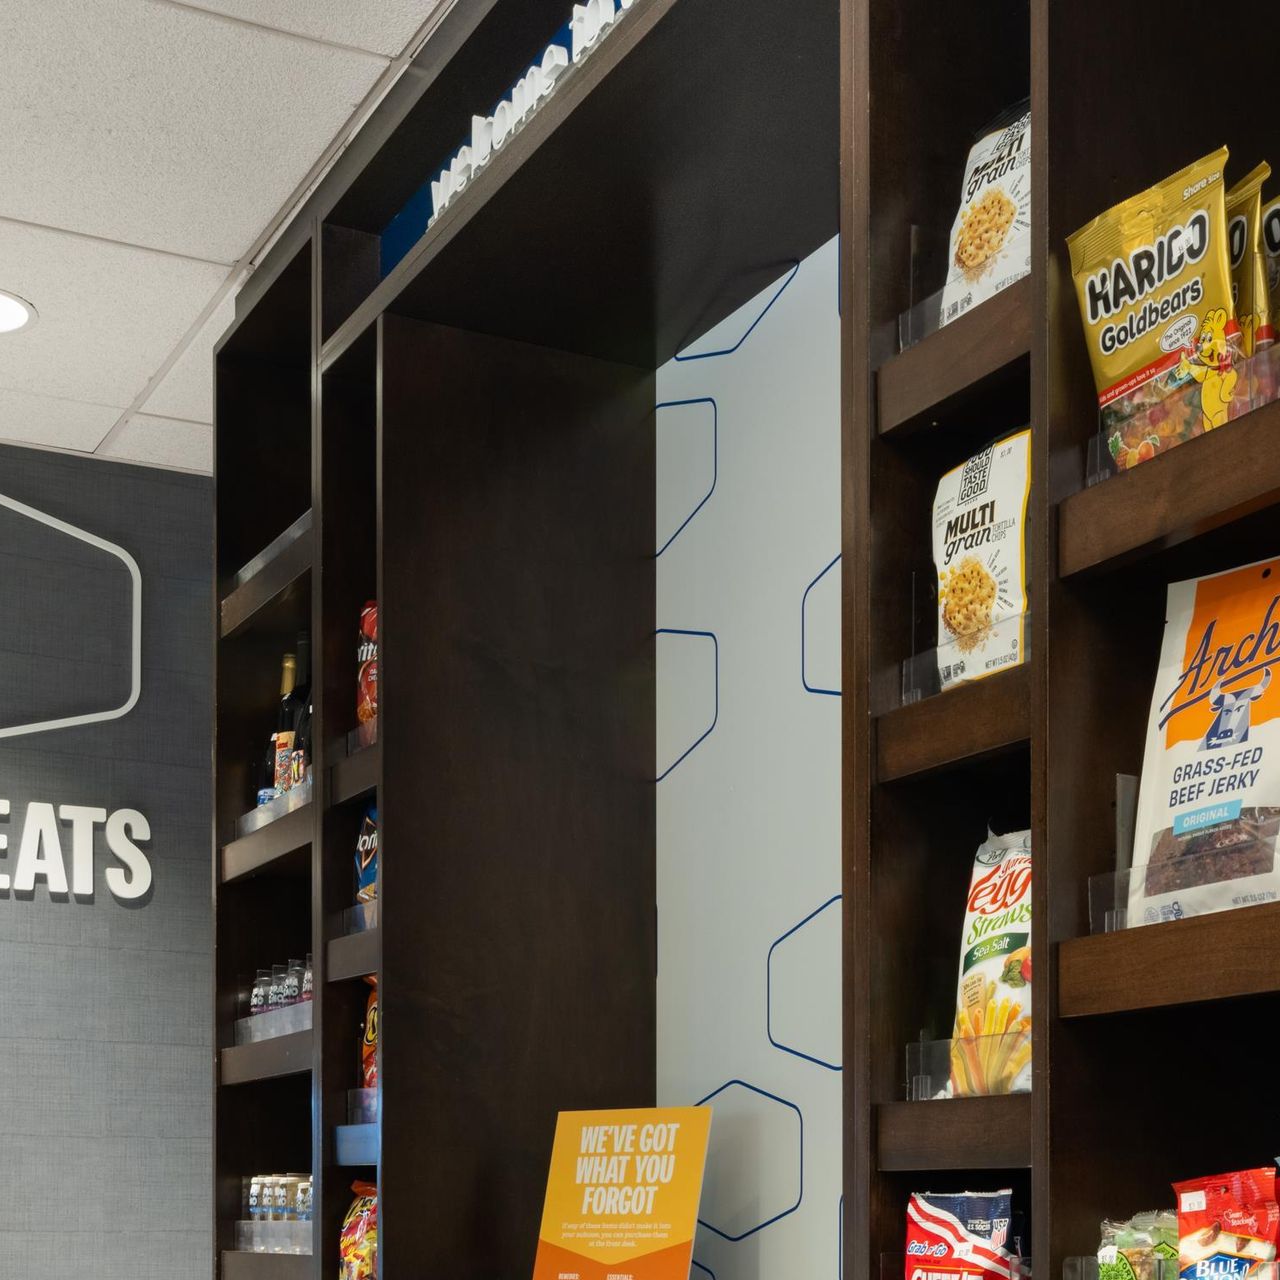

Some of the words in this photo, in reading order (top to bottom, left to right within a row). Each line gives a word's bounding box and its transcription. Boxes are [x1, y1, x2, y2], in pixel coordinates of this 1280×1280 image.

[965, 156, 1017, 204] grain
[1183, 178, 1207, 201] Share
[1100, 276, 1203, 356] Goldbears
[962, 471, 988, 489] TASTE
[964, 458, 991, 477] SHOULD
[960, 481, 987, 501] GOOD
[944, 500, 997, 546] MULTI
[992, 518, 1016, 535] TORTILLA
[992, 529, 1007, 544] CHIPS
[944, 526, 993, 566] grain
[1173, 746, 1264, 785] GRASS-FED
[1169, 784, 1206, 808] BEEF
[1208, 769, 1260, 798] JERKY
[1183, 806, 1230, 829] ORIGINAL
[968, 863, 1032, 916] Vegg
[967, 903, 1032, 946] Straws
[972, 941, 991, 961] Sea
[990, 936, 1010, 955] Salt
[580, 1123, 638, 1155] WE'VE
[639, 1122, 681, 1152] GOT
[575, 1155, 631, 1185] WHAT
[635, 1153, 676, 1184] YOU
[581, 1185, 658, 1216] FORGOT
[907, 1240, 928, 1256] Grab
[933, 1242, 949, 1257] Go
[1196, 1258, 1240, 1278] BLUE
